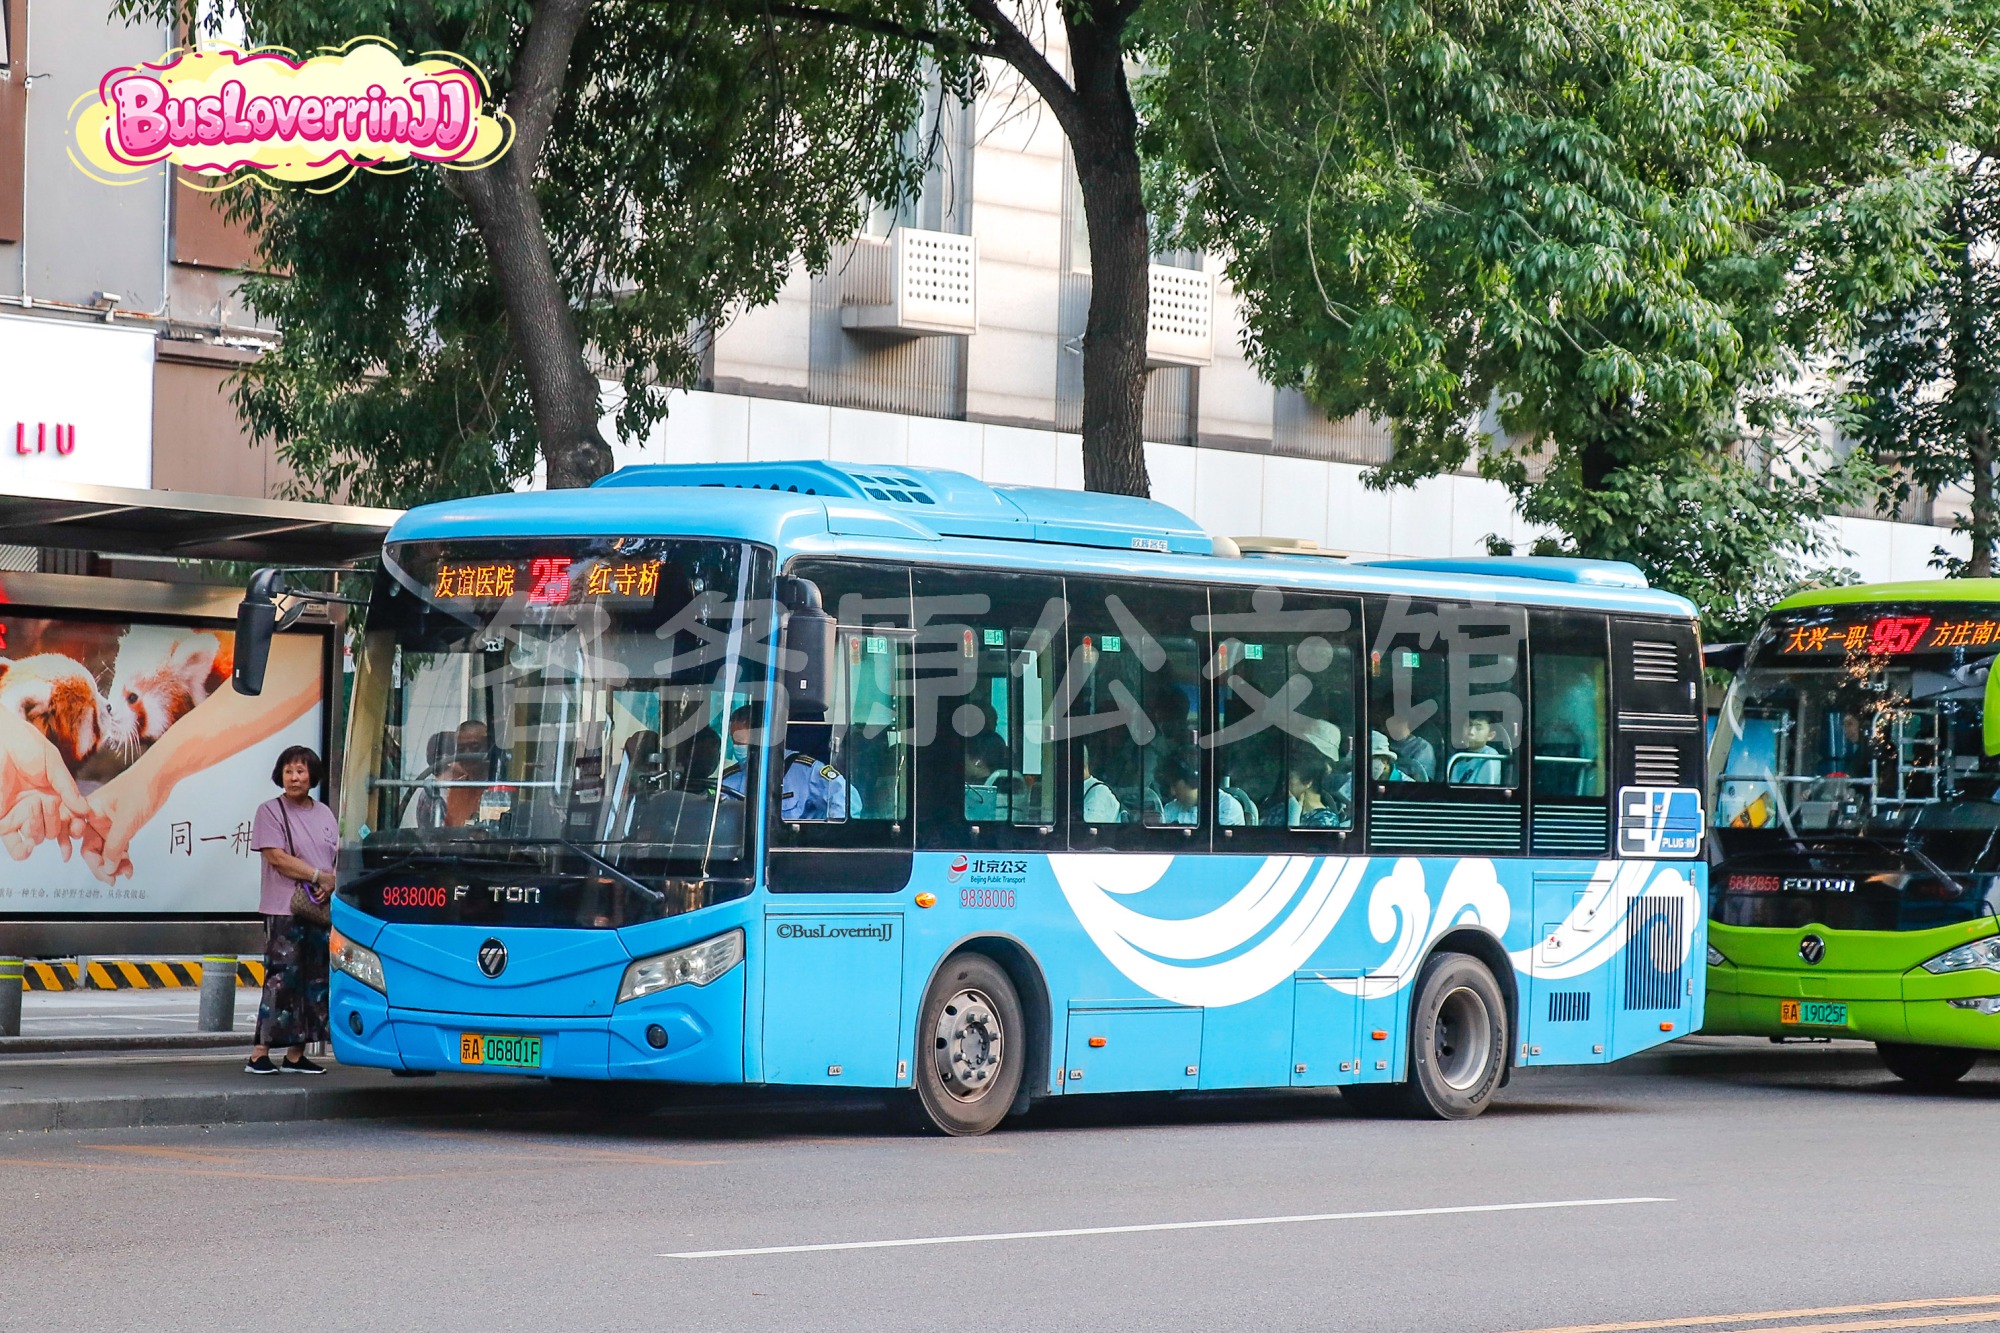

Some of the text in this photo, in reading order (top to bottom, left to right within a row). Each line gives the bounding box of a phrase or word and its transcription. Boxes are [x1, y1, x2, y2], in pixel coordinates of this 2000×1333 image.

[16, 421, 75, 455] LIU
[434, 558, 661, 602] 友谊医院 25 红寺桥
[1784, 625, 1869, 654] 大兴一职
[1868, 615, 1931, 653] 957
[1620, 790, 1674, 856] EV
[169, 820, 253, 859] 同一种
[1661, 837, 1695, 849] PLUG-IN
[970, 875, 1026, 885] Beijing Public Transport
[971, 859, 1028, 874] 北京公交
[383, 886, 447, 907] 9838006
[961, 888, 1016, 908] 9838006
